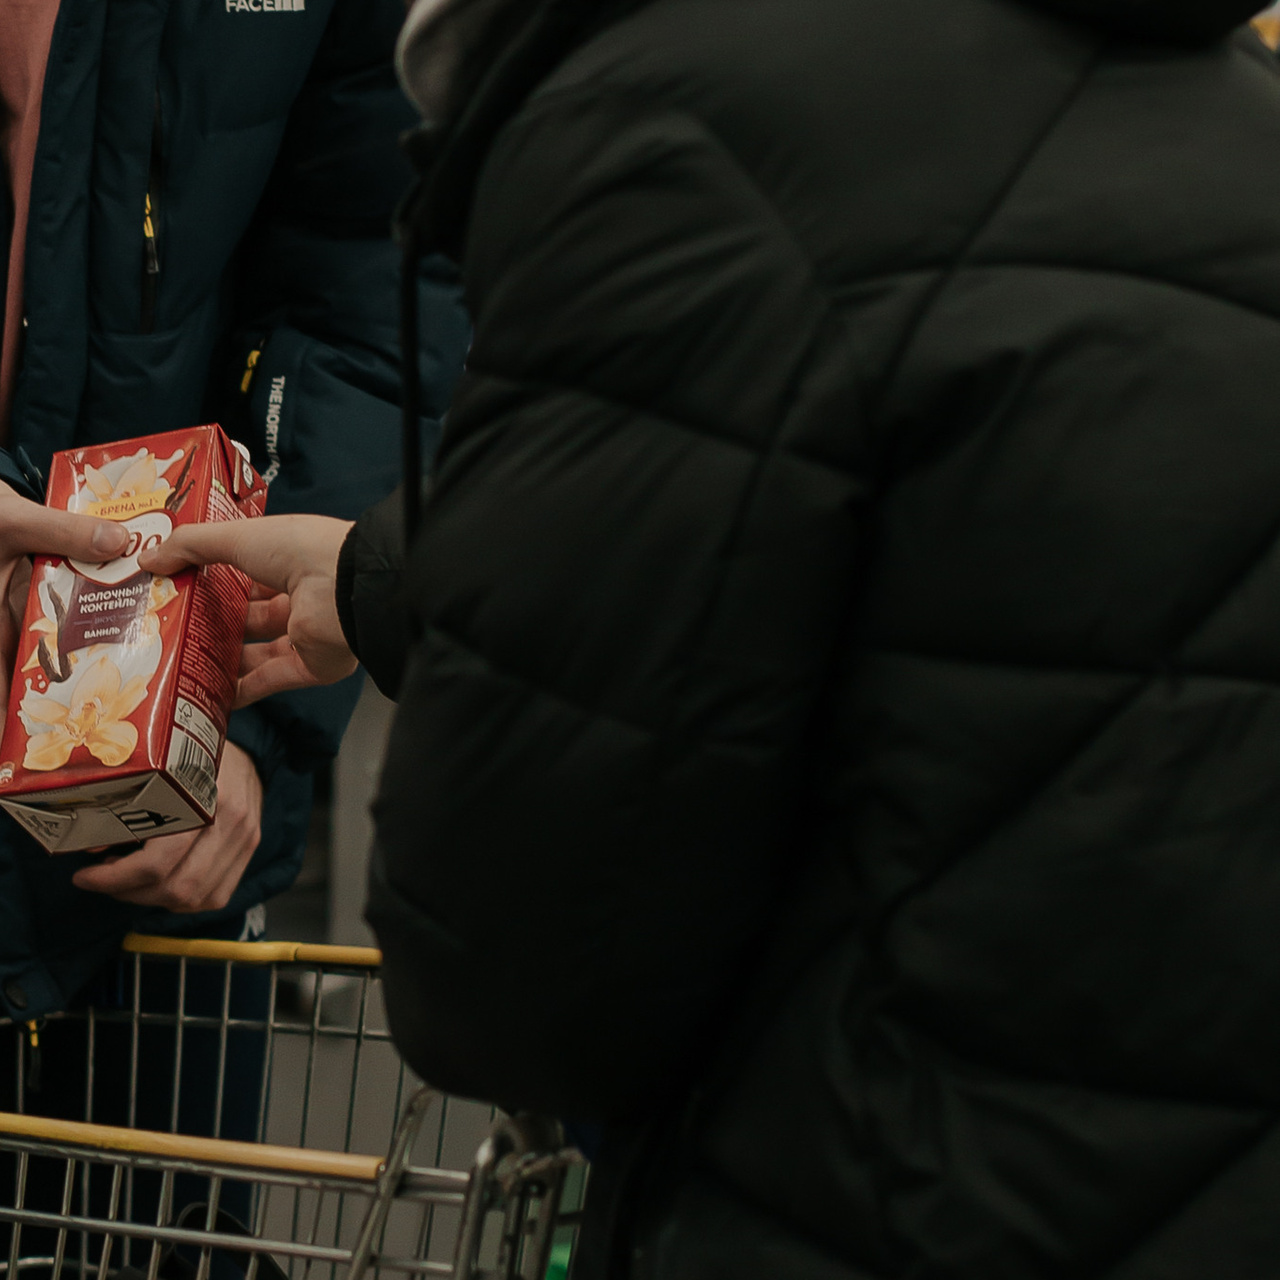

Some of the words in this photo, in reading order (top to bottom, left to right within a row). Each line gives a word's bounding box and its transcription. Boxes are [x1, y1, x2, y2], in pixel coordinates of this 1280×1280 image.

[269, 375, 285, 404] THE
[266, 403, 281, 453] NORTH
[78, 584, 144, 604] МОЛОЧНЫЙ
[80, 598, 137, 614] КОКТЕЙЛЬ
[84, 627, 121, 639] ВАНИЛЬ
